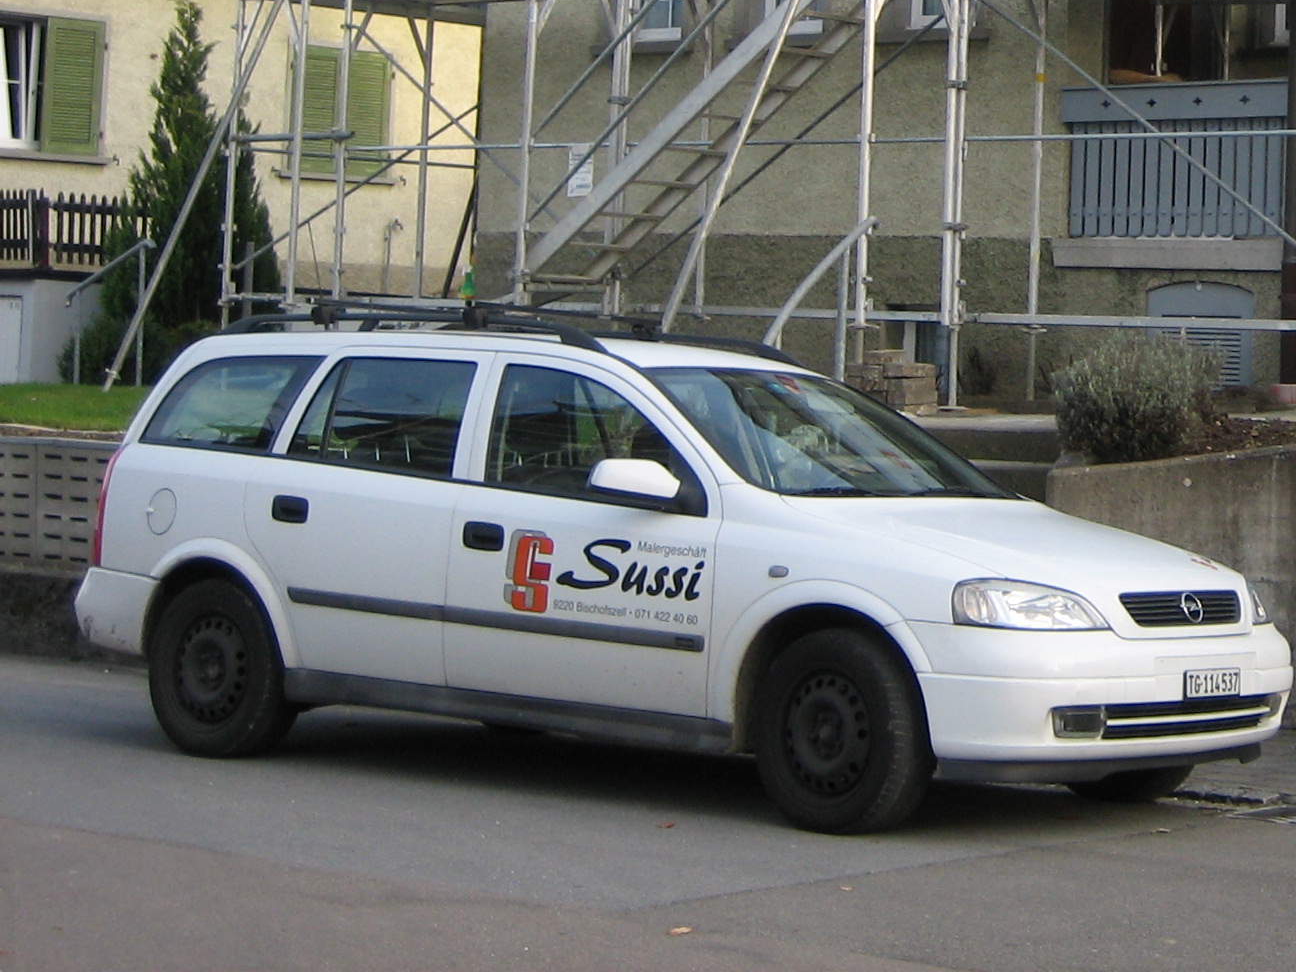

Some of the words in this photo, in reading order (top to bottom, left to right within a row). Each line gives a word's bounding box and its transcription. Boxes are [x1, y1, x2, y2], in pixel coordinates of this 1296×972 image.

[637, 540, 708, 558] Malergeschäft
[556, 538, 705, 601] Sussi
[553, 599, 575, 612] 9220
[576, 601, 627, 618] Bischofszell
[634, 609, 651, 620] 071
[653, 611, 671, 623] 422
[672, 613, 685, 624] 40
[686, 614, 699, 625] 60
